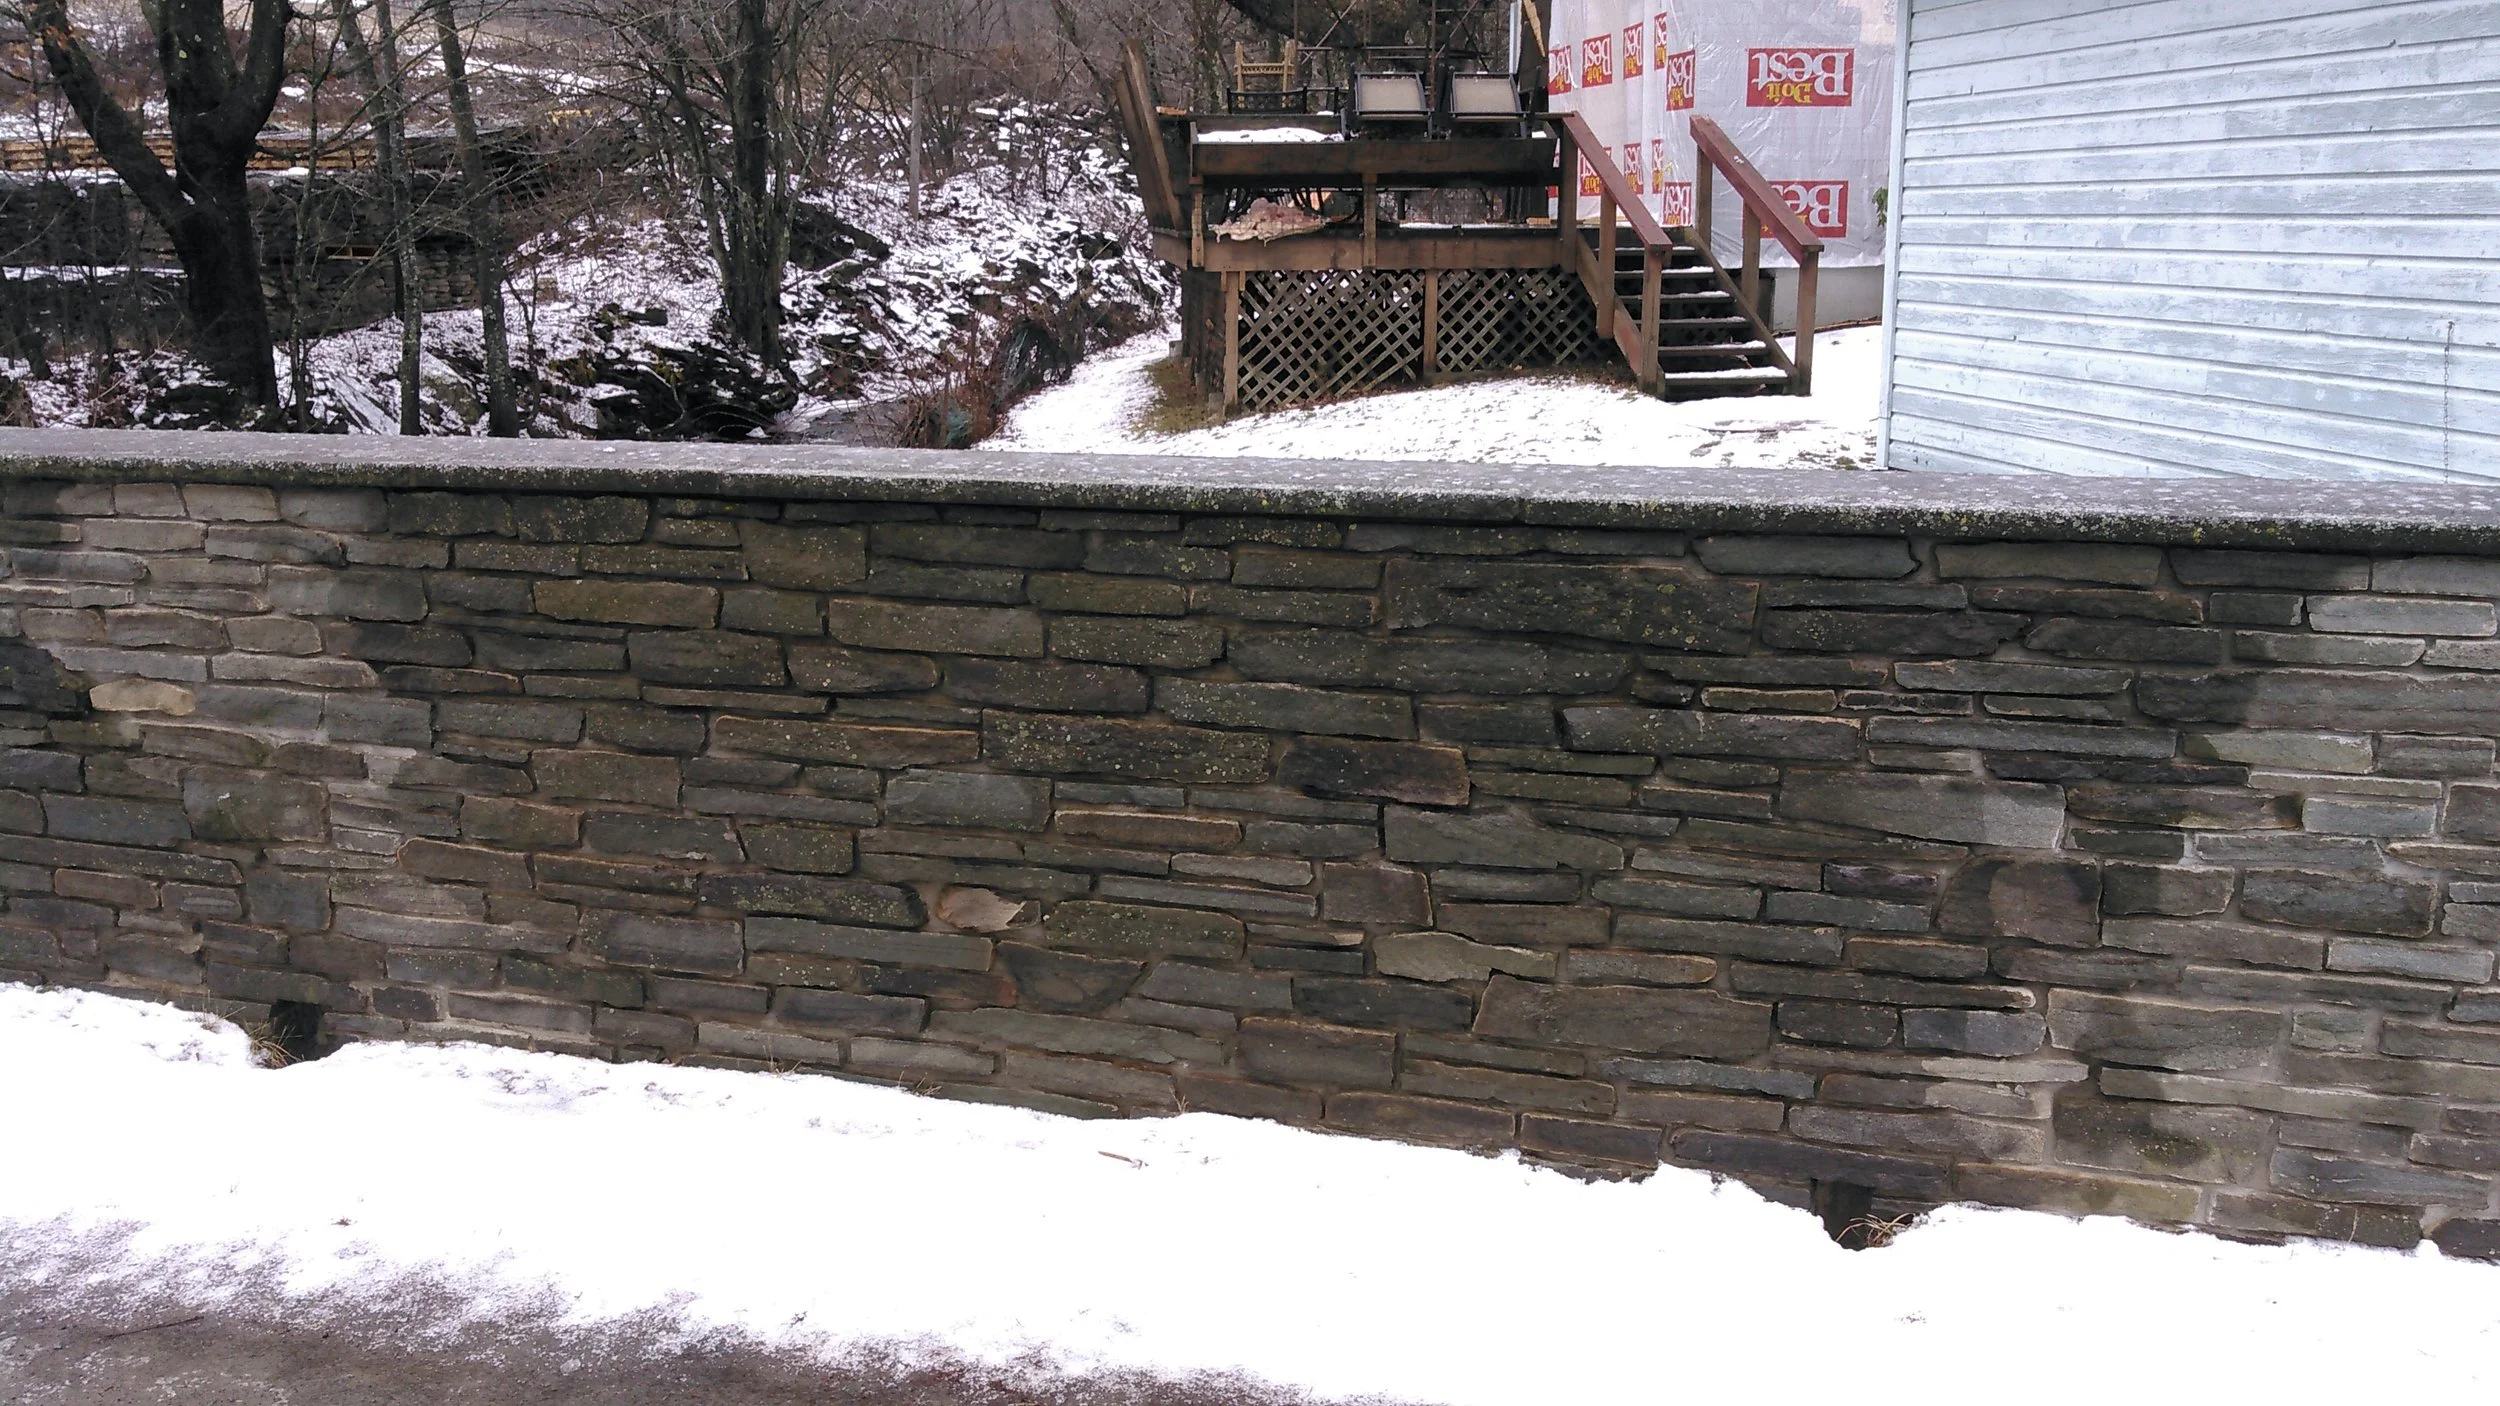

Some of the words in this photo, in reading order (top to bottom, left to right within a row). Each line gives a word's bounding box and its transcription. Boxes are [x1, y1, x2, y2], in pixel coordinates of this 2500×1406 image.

[1584, 38, 1612, 75] Best
[1624, 27, 1643, 66] Best
[1668, 55, 1694, 98] Best
[1751, 52, 1850, 96] Best
[1766, 83, 1781, 103] it
[1781, 83, 1813, 103] Do
[1664, 186, 1691, 225] Best
[1771, 184, 1844, 228] Be
